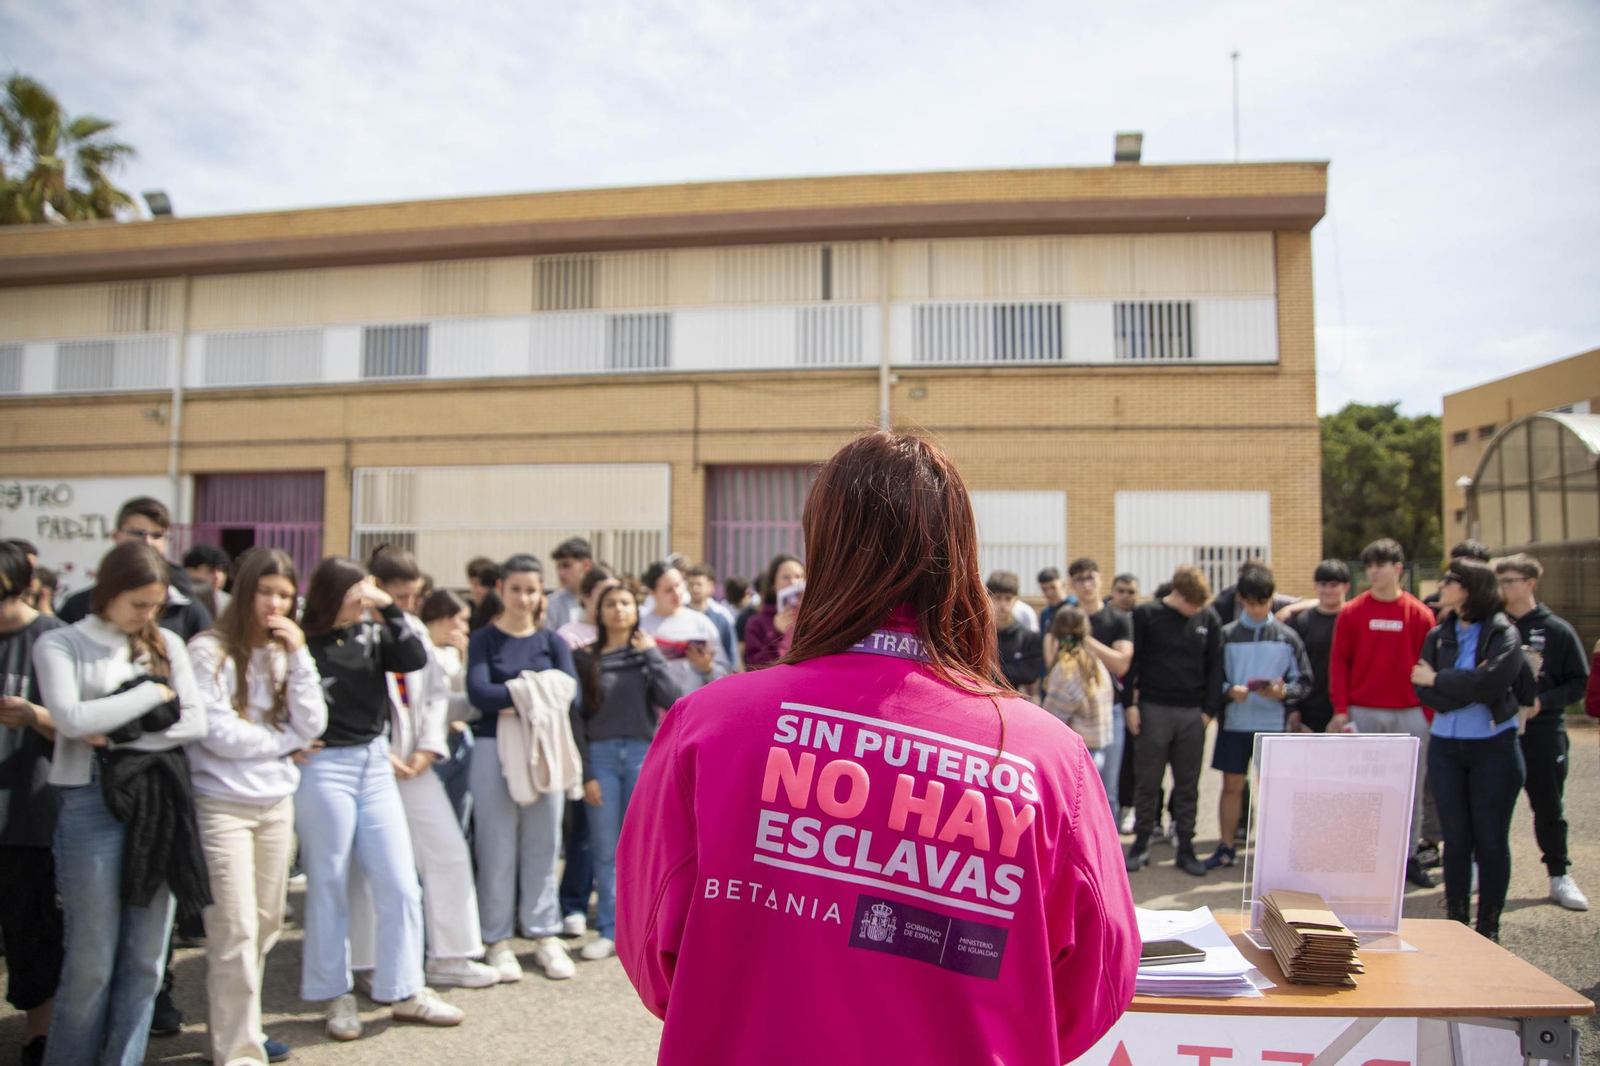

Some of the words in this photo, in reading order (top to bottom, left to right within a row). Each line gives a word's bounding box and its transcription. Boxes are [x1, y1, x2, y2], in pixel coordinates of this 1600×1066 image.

[773, 714, 843, 752] SIN
[854, 728, 1039, 801] PUTEROS
[761, 746, 870, 819] NO
[888, 773, 1036, 858] HAY
[755, 808, 1025, 905] ESCLAVAS
[704, 878, 841, 924] BETANIA
[904, 929, 913, 937] DE
[914, 931, 939, 945] ESPAÑA
[905, 922, 941, 938] GOBIERNO
[959, 937, 994, 950] MINISTERIO
[958, 944, 967, 952] DE
[968, 948, 998, 958] IGUALDAD
